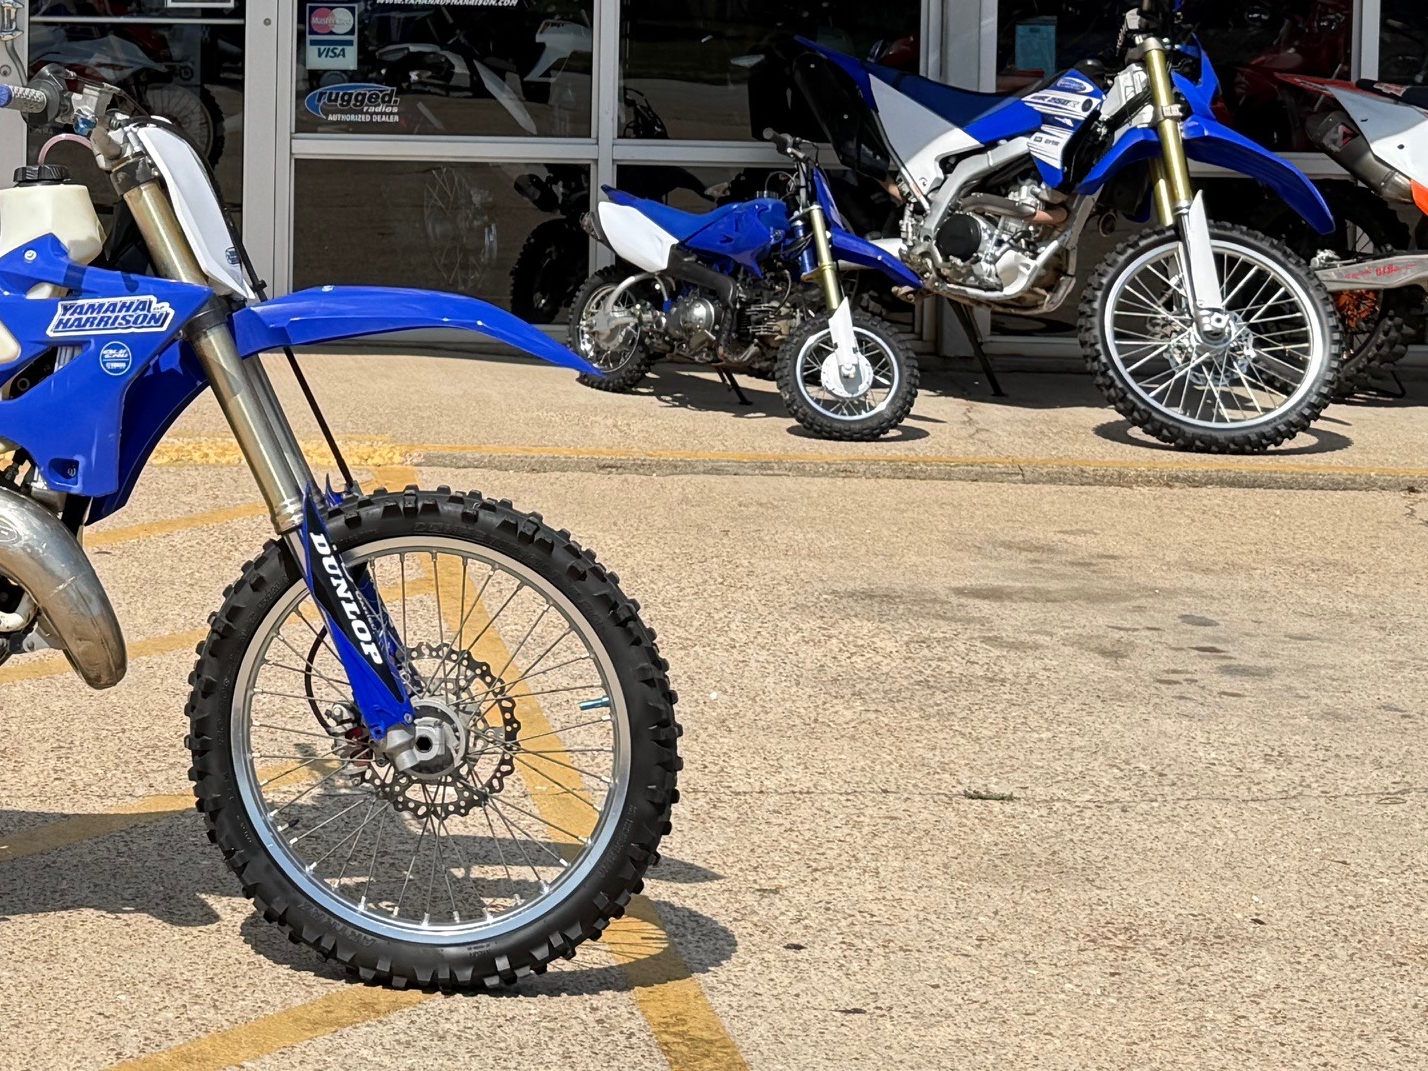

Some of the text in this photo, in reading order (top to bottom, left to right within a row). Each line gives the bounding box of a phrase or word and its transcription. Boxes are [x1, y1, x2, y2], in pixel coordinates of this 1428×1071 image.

[317, 47, 347, 59] VISA
[363, 105, 399, 113] radios
[327, 113, 400, 123] AUTHORIZED DEALER
[61, 298, 152, 317] YAMAHA
[54, 312, 168, 331] HARRISON
[310, 533, 383, 665] DUNLOP
